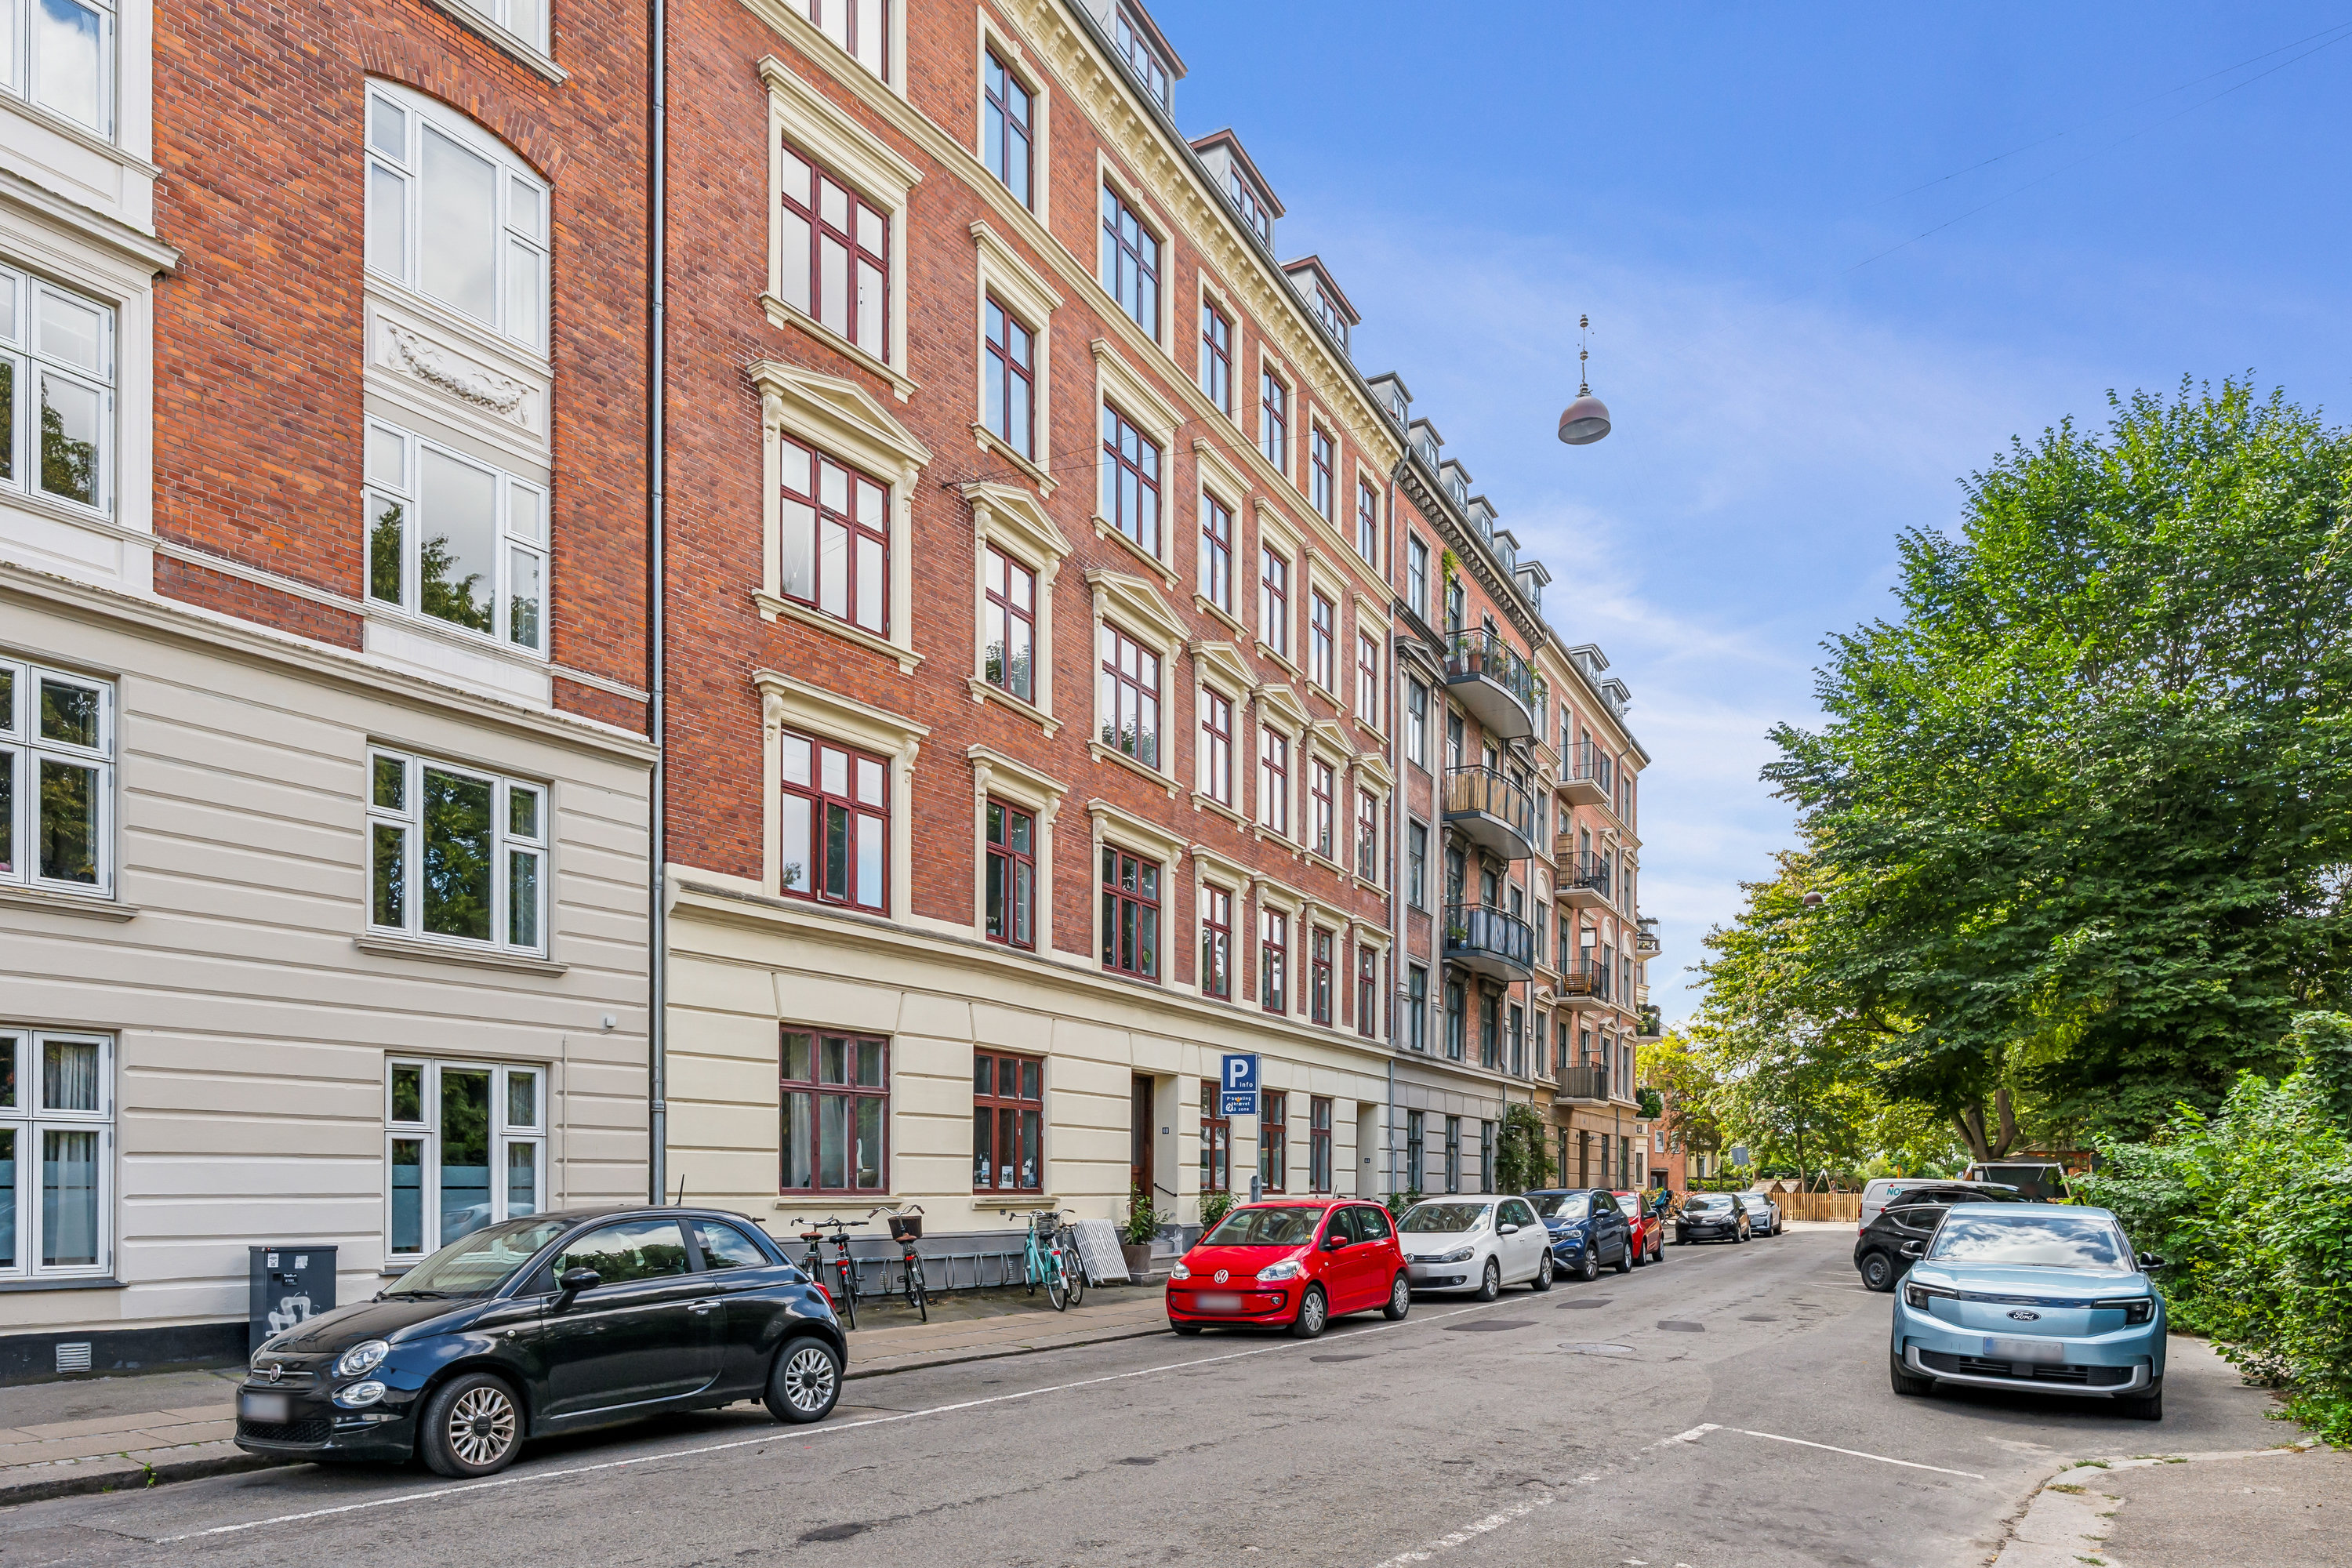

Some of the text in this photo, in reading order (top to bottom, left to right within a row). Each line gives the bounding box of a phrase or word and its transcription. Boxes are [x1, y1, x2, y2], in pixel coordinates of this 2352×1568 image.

[1230, 1059, 1249, 1087] P
[1886, 1187, 1906, 1196] NO
[2013, 1311, 2035, 1321] Ford
